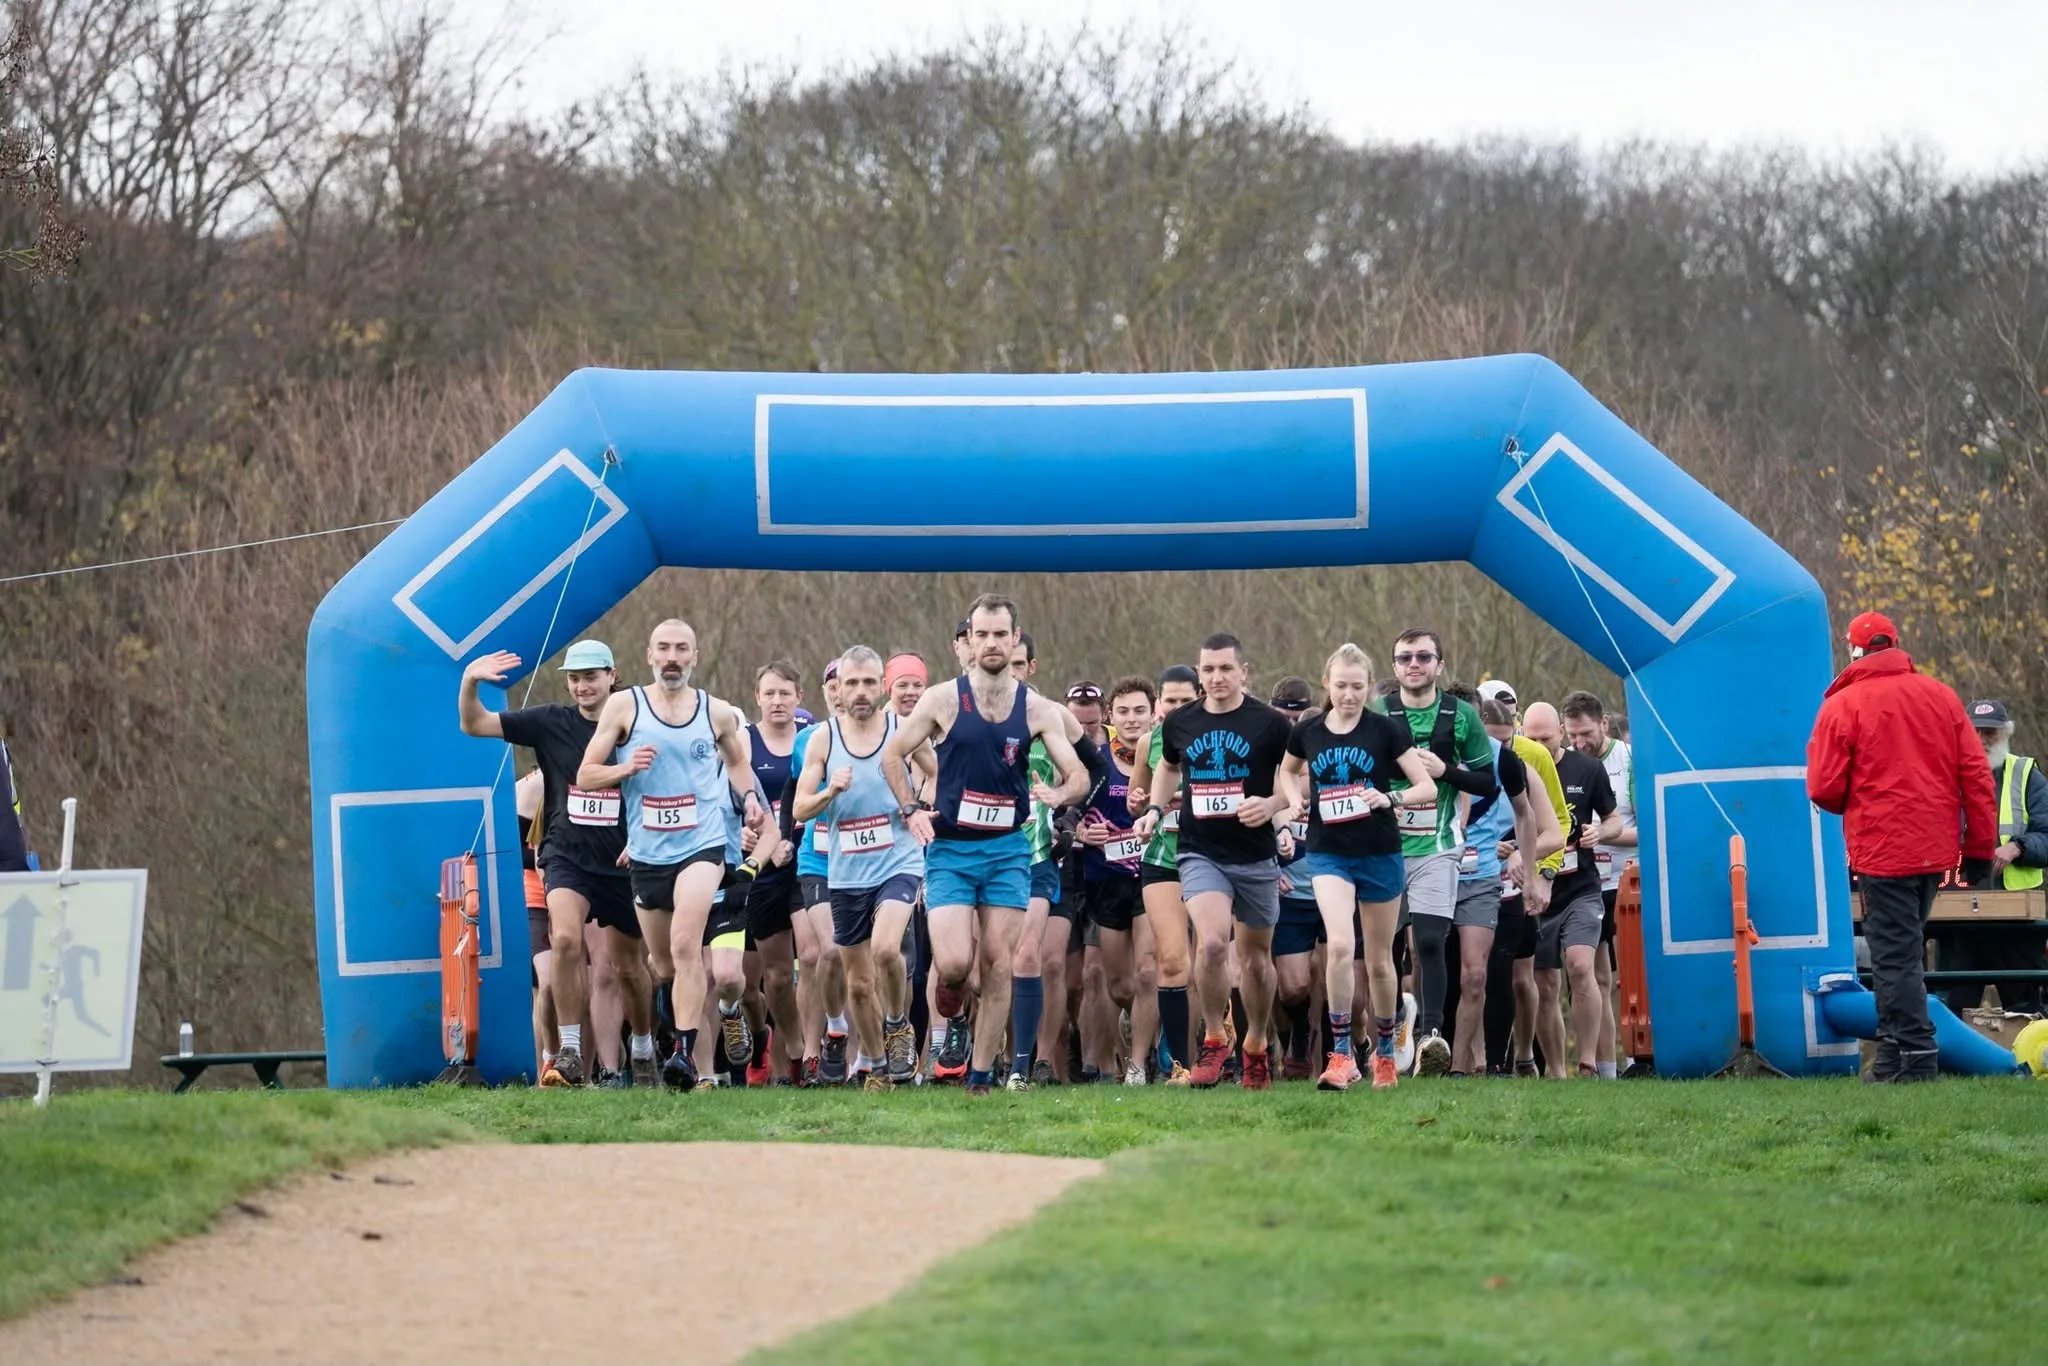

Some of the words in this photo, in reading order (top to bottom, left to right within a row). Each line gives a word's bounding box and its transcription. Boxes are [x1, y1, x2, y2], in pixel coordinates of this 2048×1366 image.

[1186, 730, 1250, 761] ROCHFORD
[1311, 747, 1374, 777] ROCHFORD
[1189, 766, 1226, 780] Running
[1229, 763, 1250, 777] Club
[583, 799, 602, 814] 181
[1206, 797, 1228, 811] 165
[1332, 799, 1354, 816] 174
[658, 809, 680, 824] 155
[977, 807, 999, 822] 117
[1407, 811, 1415, 824] 2
[854, 830, 876, 846] 164
[1120, 840, 1142, 855] 136
